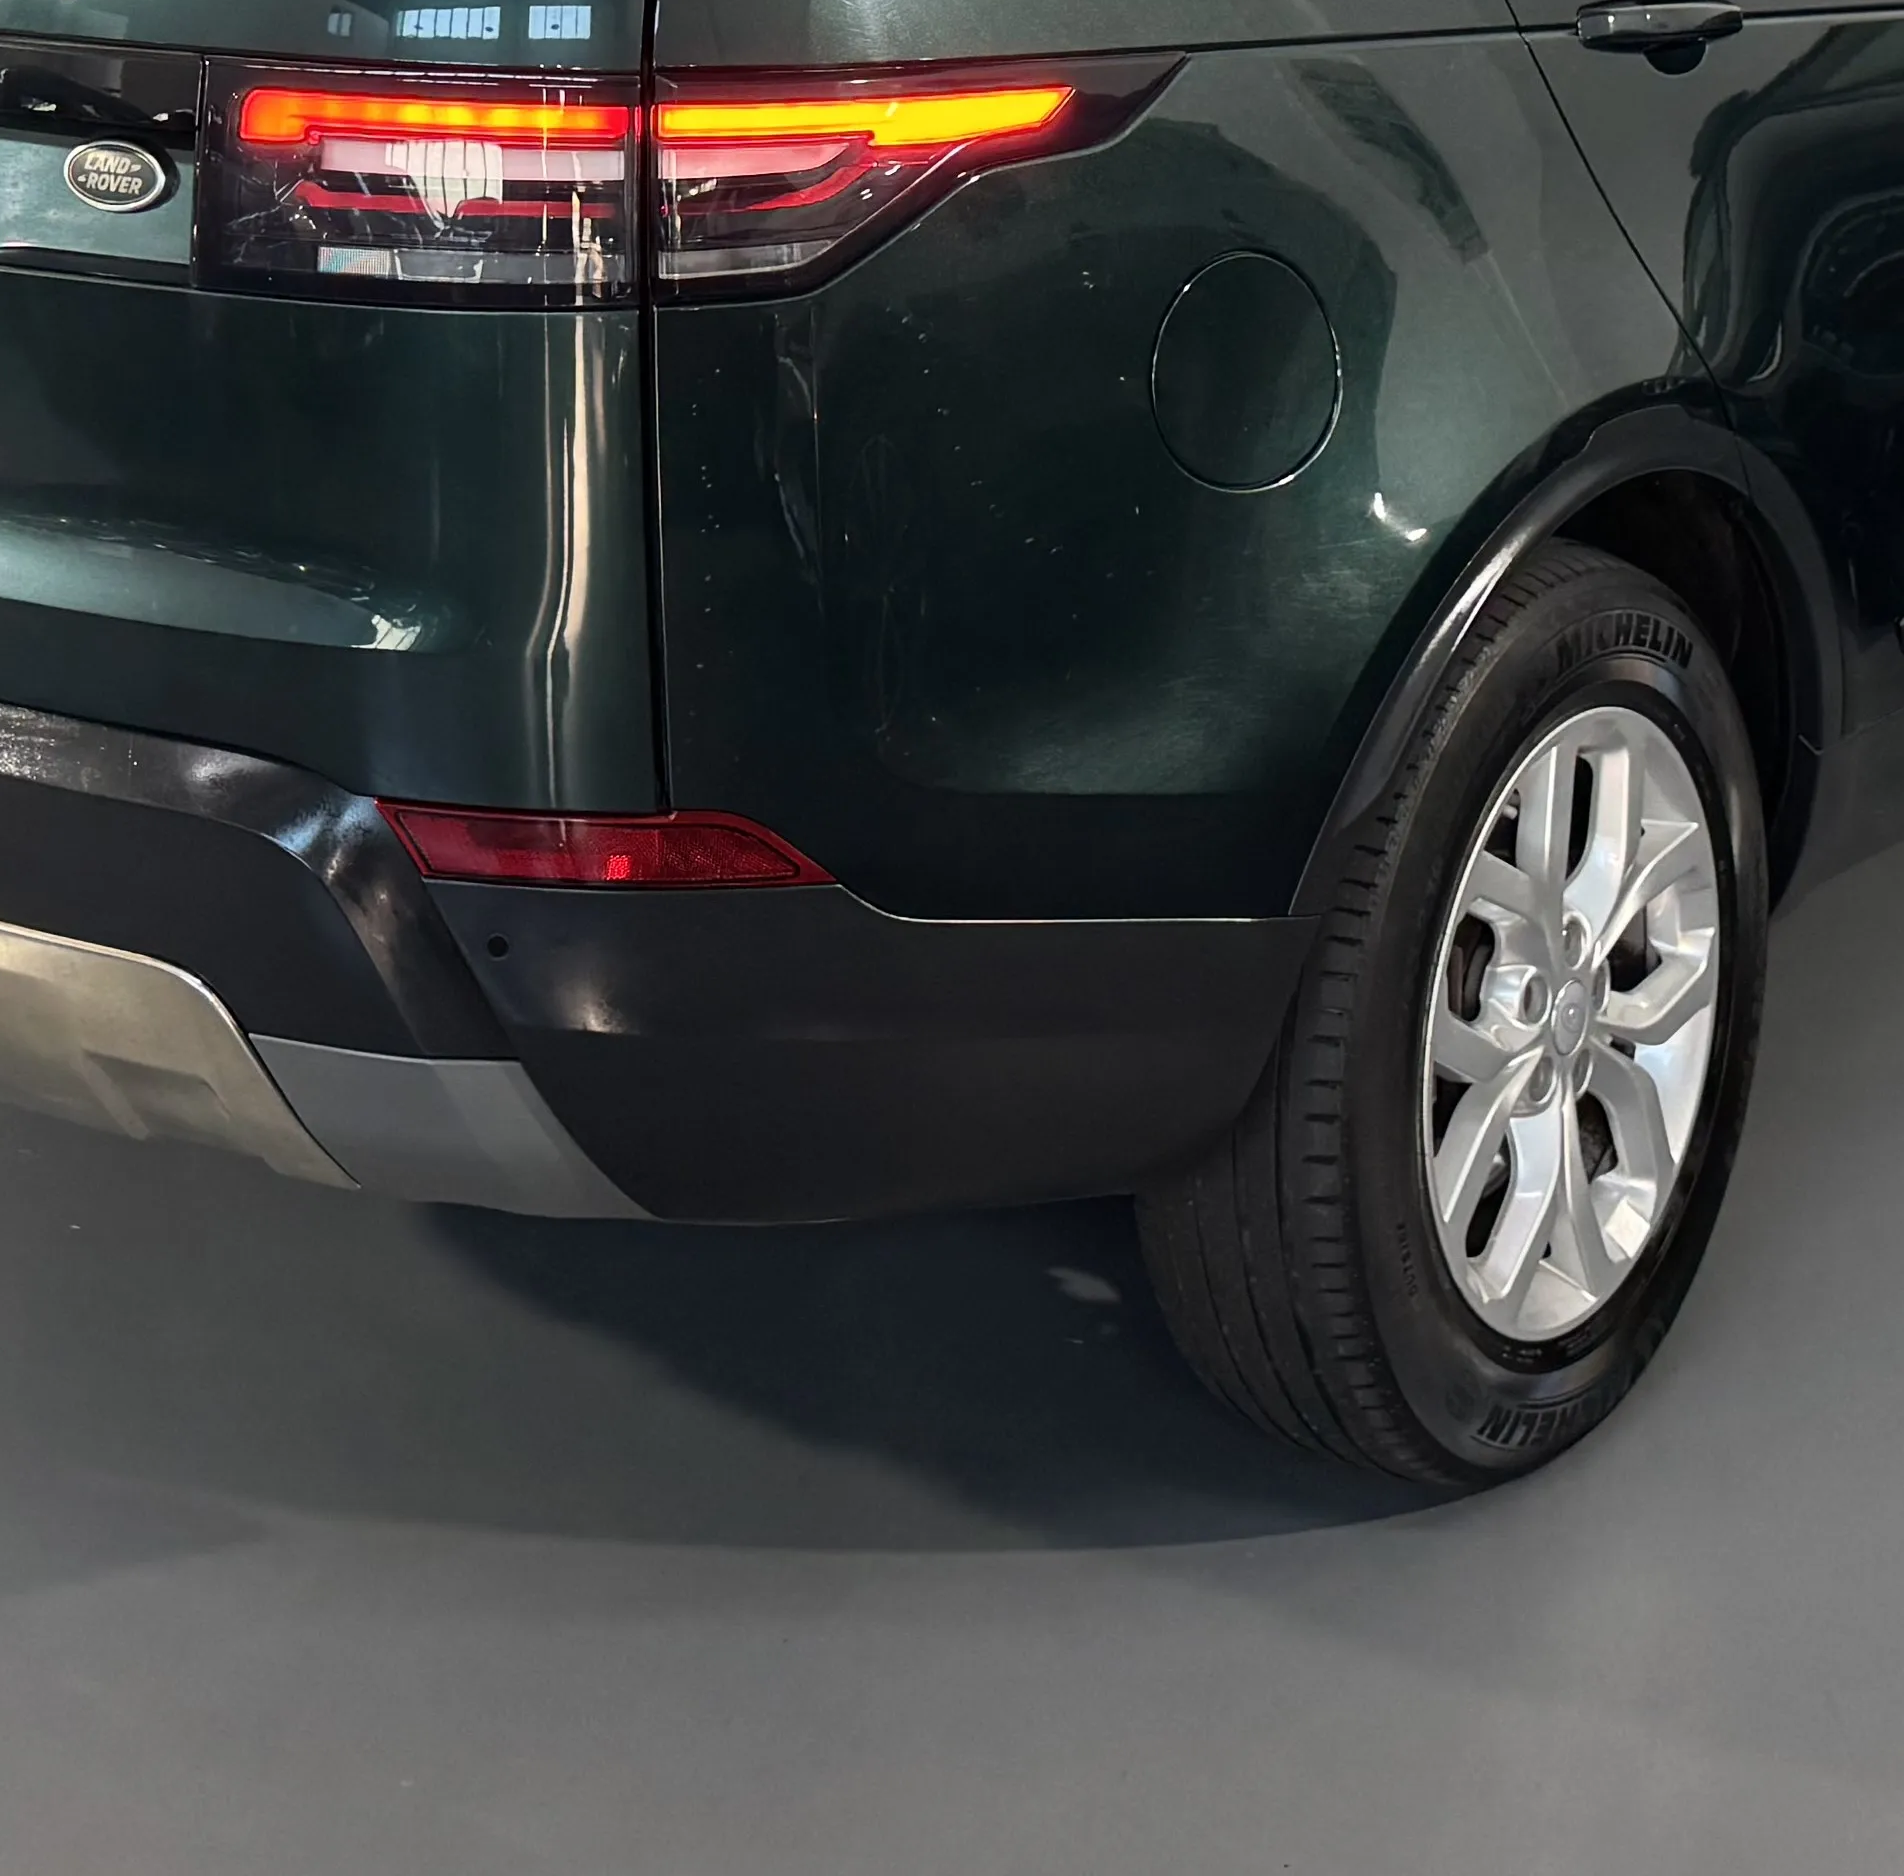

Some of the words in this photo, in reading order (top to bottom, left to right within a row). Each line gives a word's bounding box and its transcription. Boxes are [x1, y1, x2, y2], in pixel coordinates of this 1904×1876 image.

[84, 150, 132, 174] LAND
[86, 172, 143, 195] ROVER
[1556, 611, 1694, 675] MICHELIN
